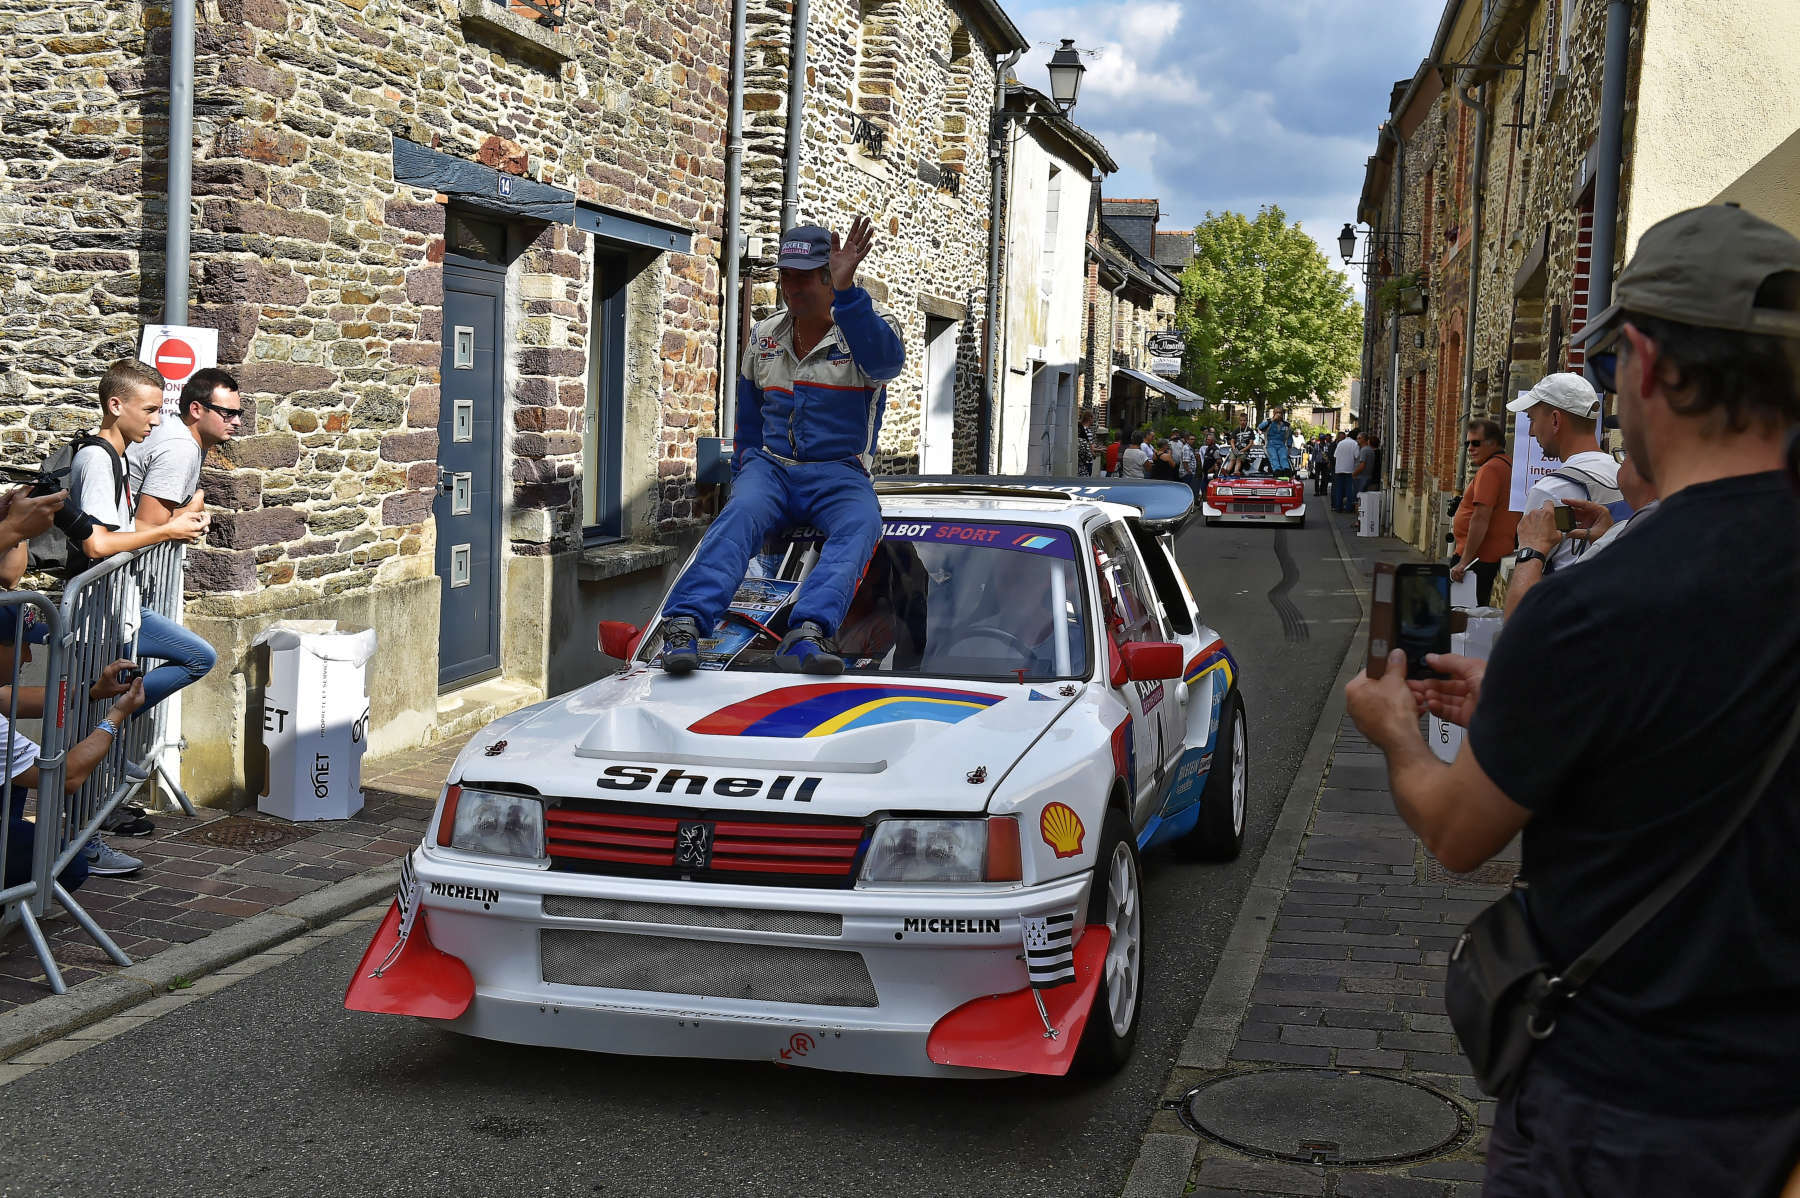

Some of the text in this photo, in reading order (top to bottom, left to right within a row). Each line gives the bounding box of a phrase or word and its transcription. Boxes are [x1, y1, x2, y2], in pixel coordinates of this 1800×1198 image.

[501, 178, 510, 194] 14
[165, 383, 184, 391] ON
[1530, 465, 1556, 475] inter
[881, 523, 931, 536] ALBOT
[935, 526, 1001, 542] SPORT
[264, 706, 289, 734] ET
[312, 752, 329, 798] ONET
[597, 766, 823, 802] Shell
[431, 882, 500, 903] MICHELIN
[904, 918, 1000, 933] MICHELIN
